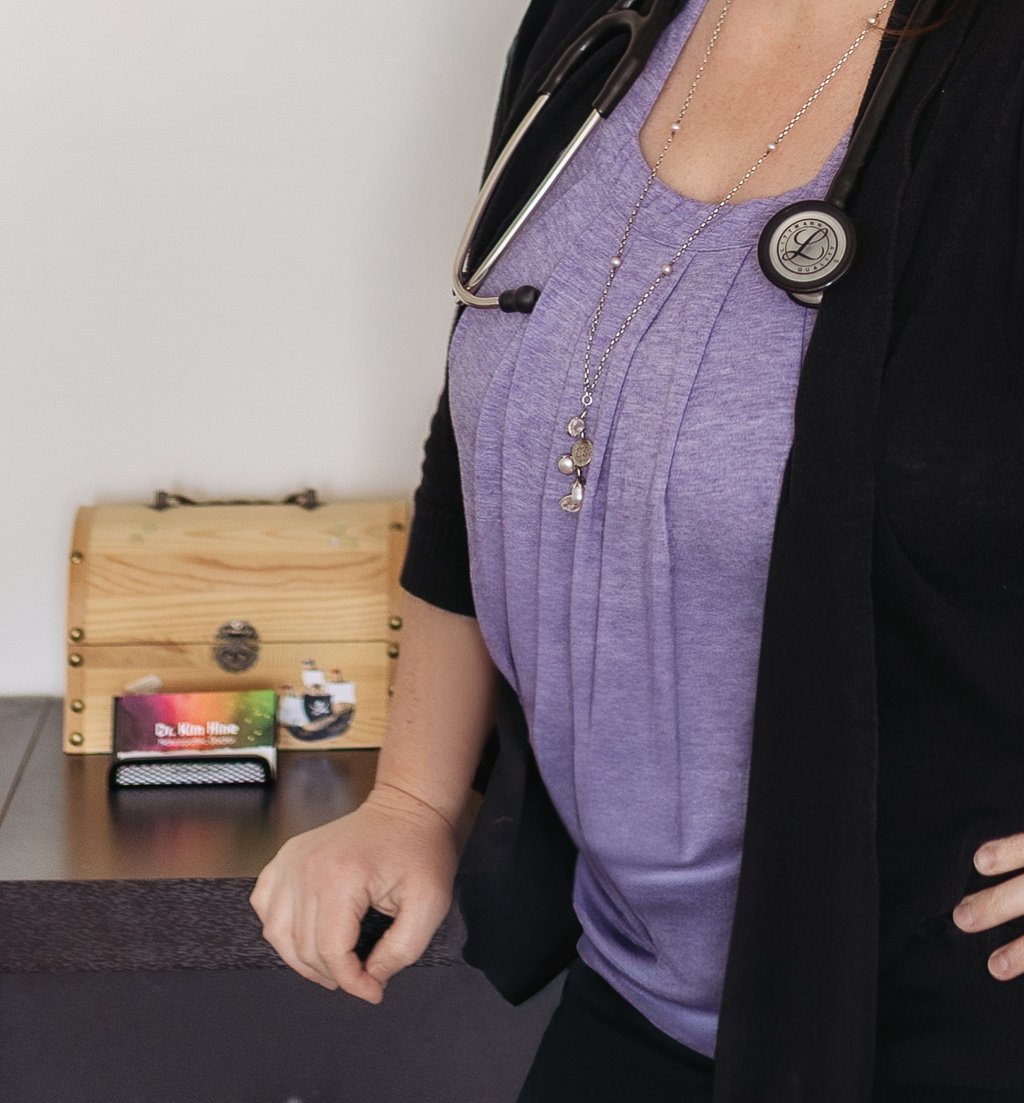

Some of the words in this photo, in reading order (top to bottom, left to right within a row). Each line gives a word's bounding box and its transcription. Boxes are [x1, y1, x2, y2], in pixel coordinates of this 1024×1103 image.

[780, 221, 822, 252] LITTMANN
[797, 246, 834, 271] QUALITY
[155, 722, 176, 737] Dr.
